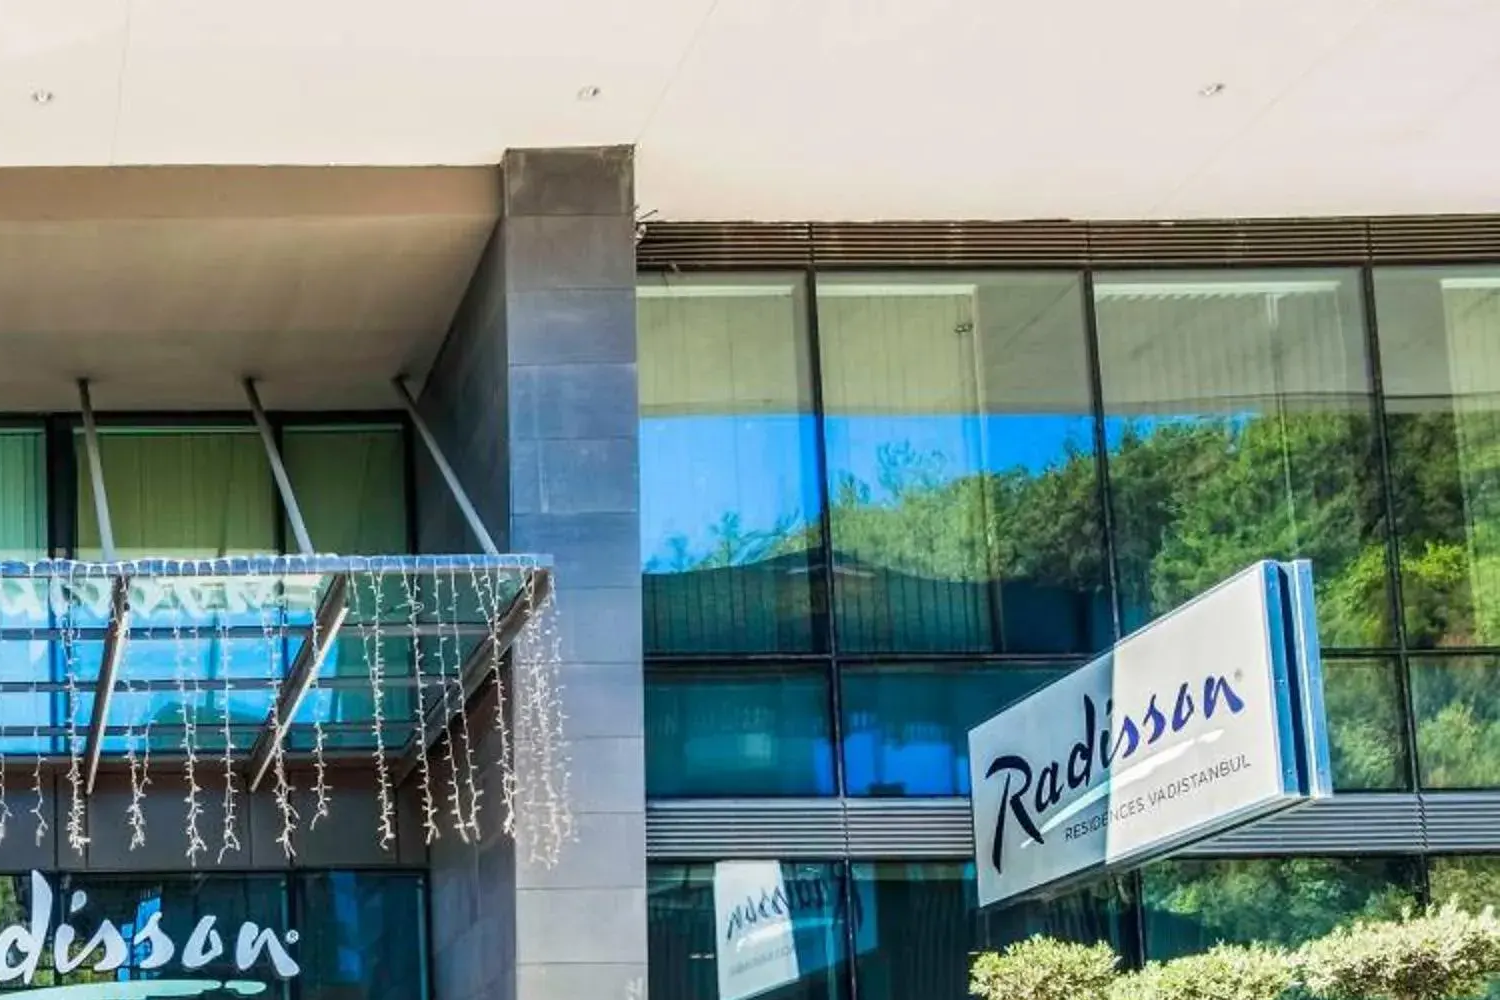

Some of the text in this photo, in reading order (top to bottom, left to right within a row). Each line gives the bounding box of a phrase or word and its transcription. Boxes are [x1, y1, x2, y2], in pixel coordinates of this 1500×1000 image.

[985, 671, 1246, 875] Radisson
[1065, 754, 1252, 841] RESIDENCES VADISTANBUL
